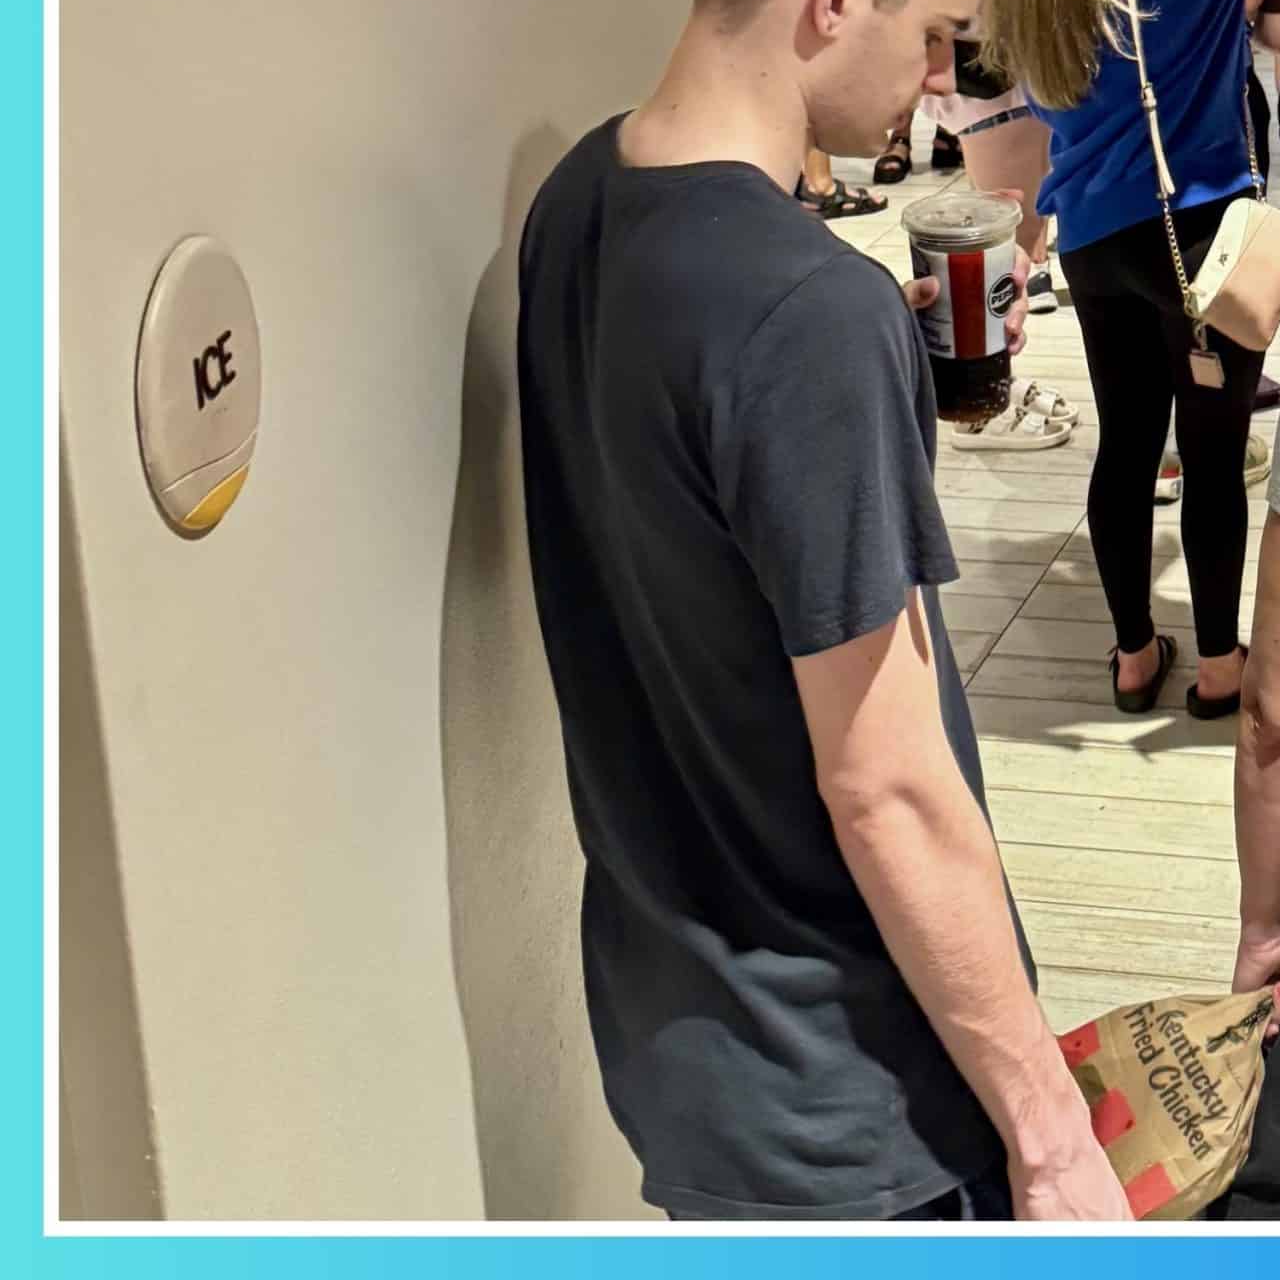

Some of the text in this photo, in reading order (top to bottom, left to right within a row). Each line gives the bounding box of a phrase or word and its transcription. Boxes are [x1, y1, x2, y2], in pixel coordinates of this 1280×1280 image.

[193, 329, 236, 411] ICE
[1124, 1001, 1213, 1161] Fried Chicken
[1155, 1009, 1228, 1123] Kentucky
